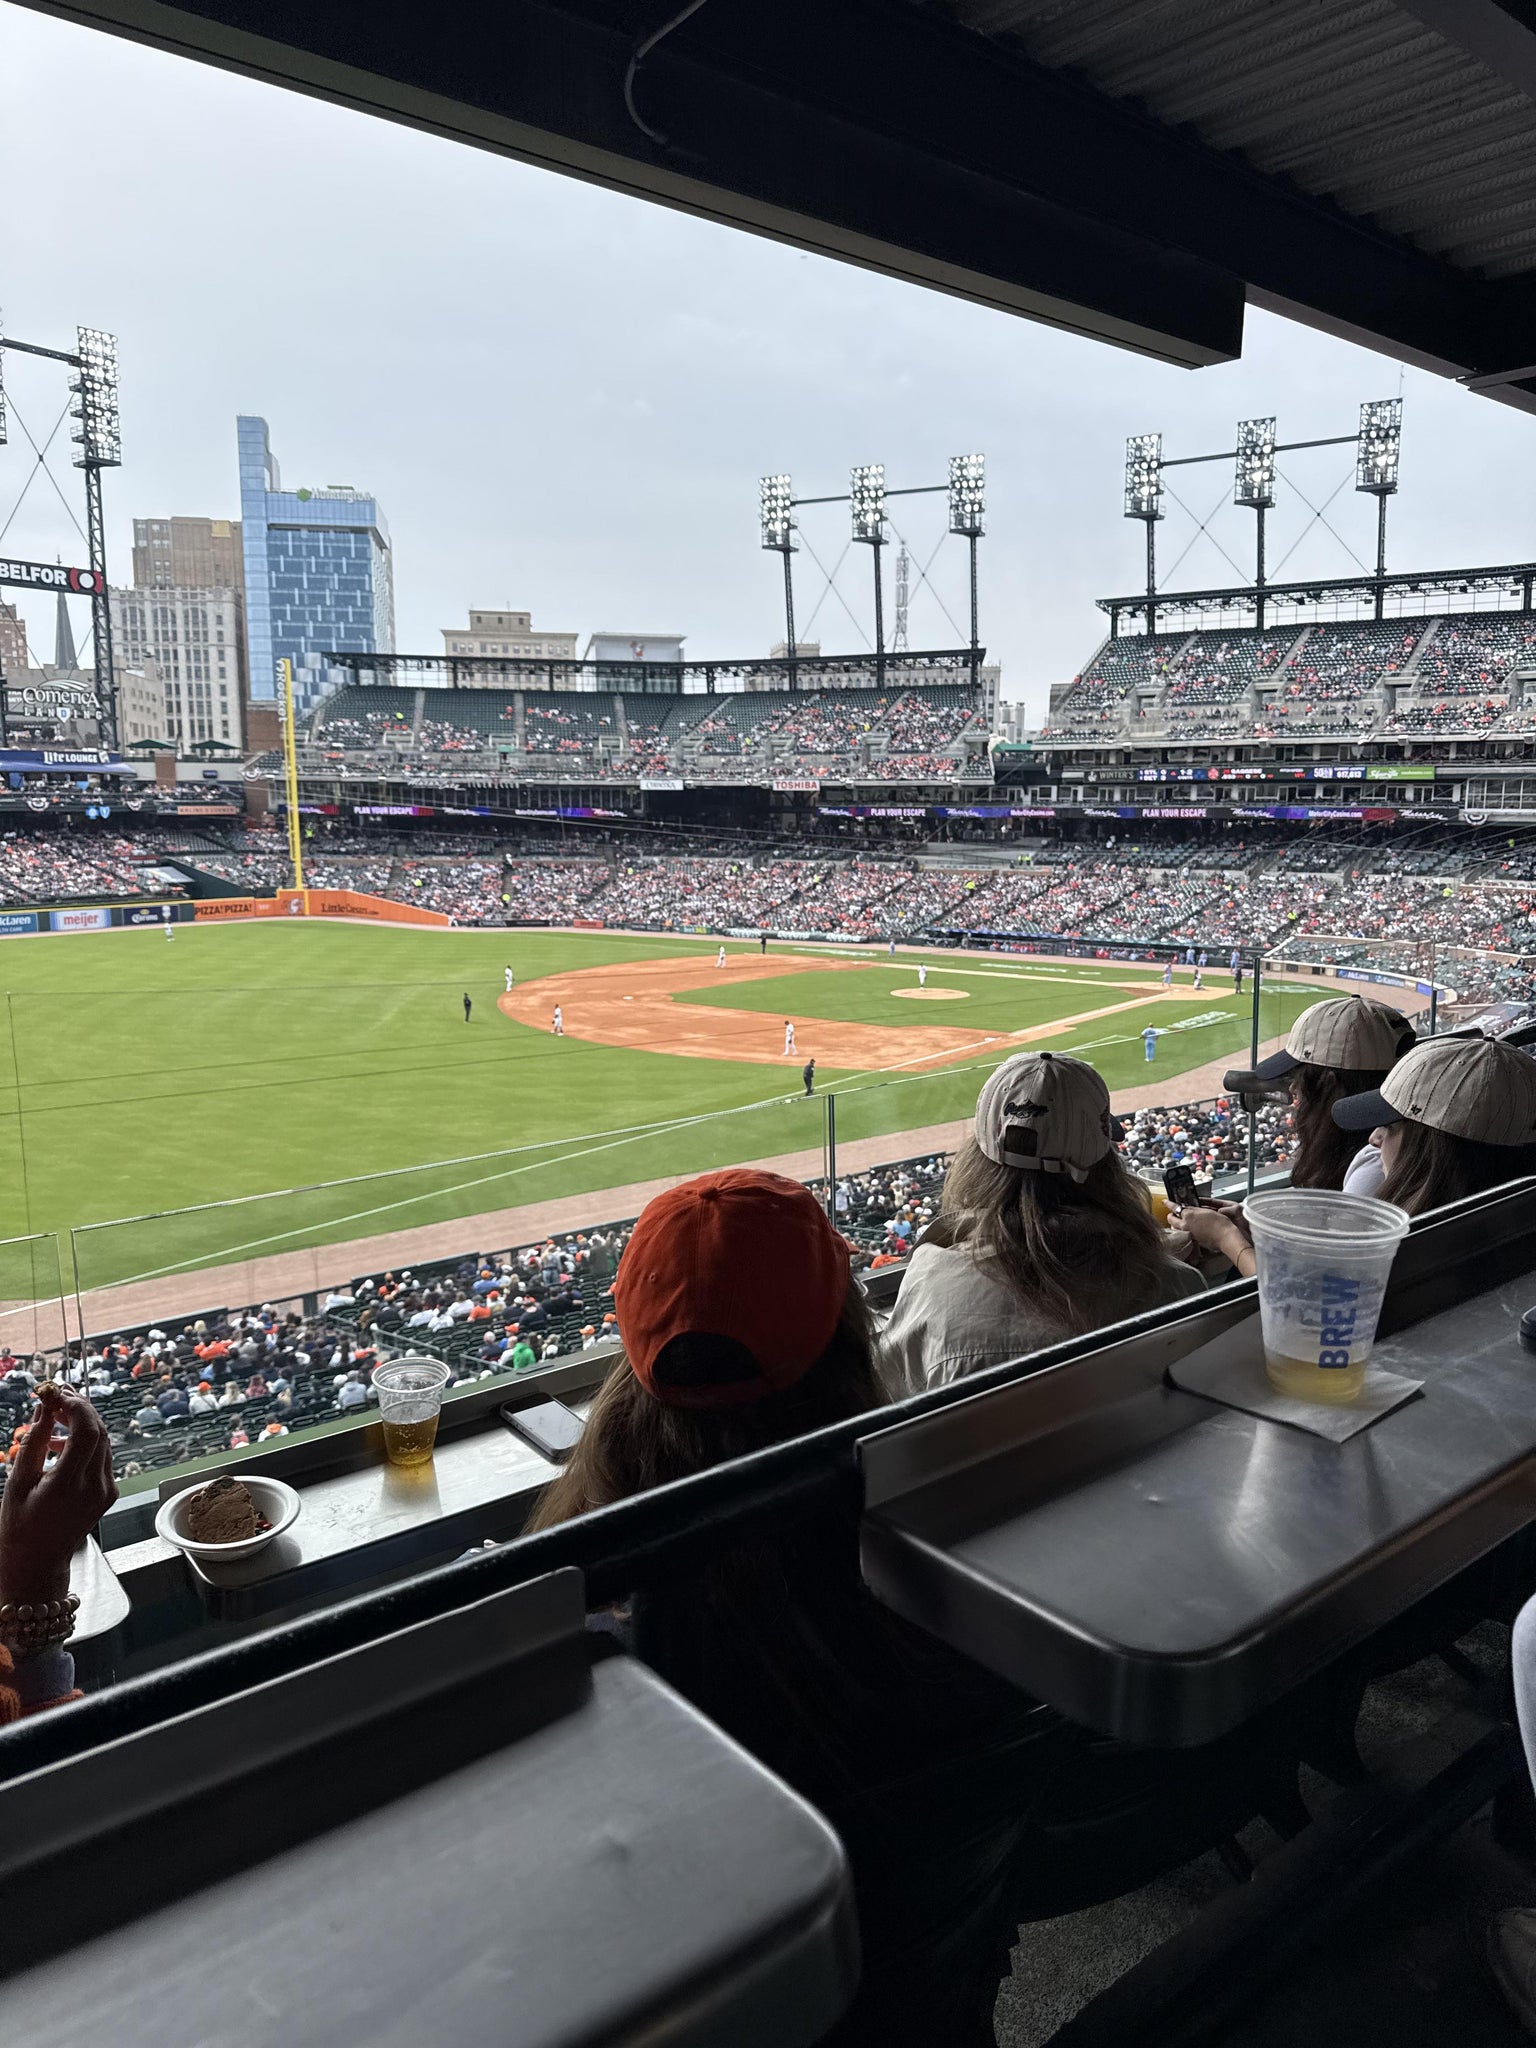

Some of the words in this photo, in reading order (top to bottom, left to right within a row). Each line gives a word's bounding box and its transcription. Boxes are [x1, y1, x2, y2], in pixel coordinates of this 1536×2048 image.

[0, 563, 67, 586] BELFOR
[44, 751, 65, 765] Lite
[65, 753, 98, 763] LOUNGE
[1100, 771, 1134, 779] WINTER'S
[775, 781, 818, 789] TOSHIBA
[389, 807, 413, 815] ESCAPE
[870, 808, 886, 816] PLAN
[903, 808, 926, 816] ESCAPE
[1142, 808, 1159, 817] PLAN
[1160, 808, 1179, 817] YOUR
[1180, 808, 1207, 817] ESCAPE
[195, 904, 223, 915] PIZZA!
[224, 903, 252, 913] PIZZA!
[64, 912, 98, 926] meijer
[1318, 1275, 1361, 1370] BREW
